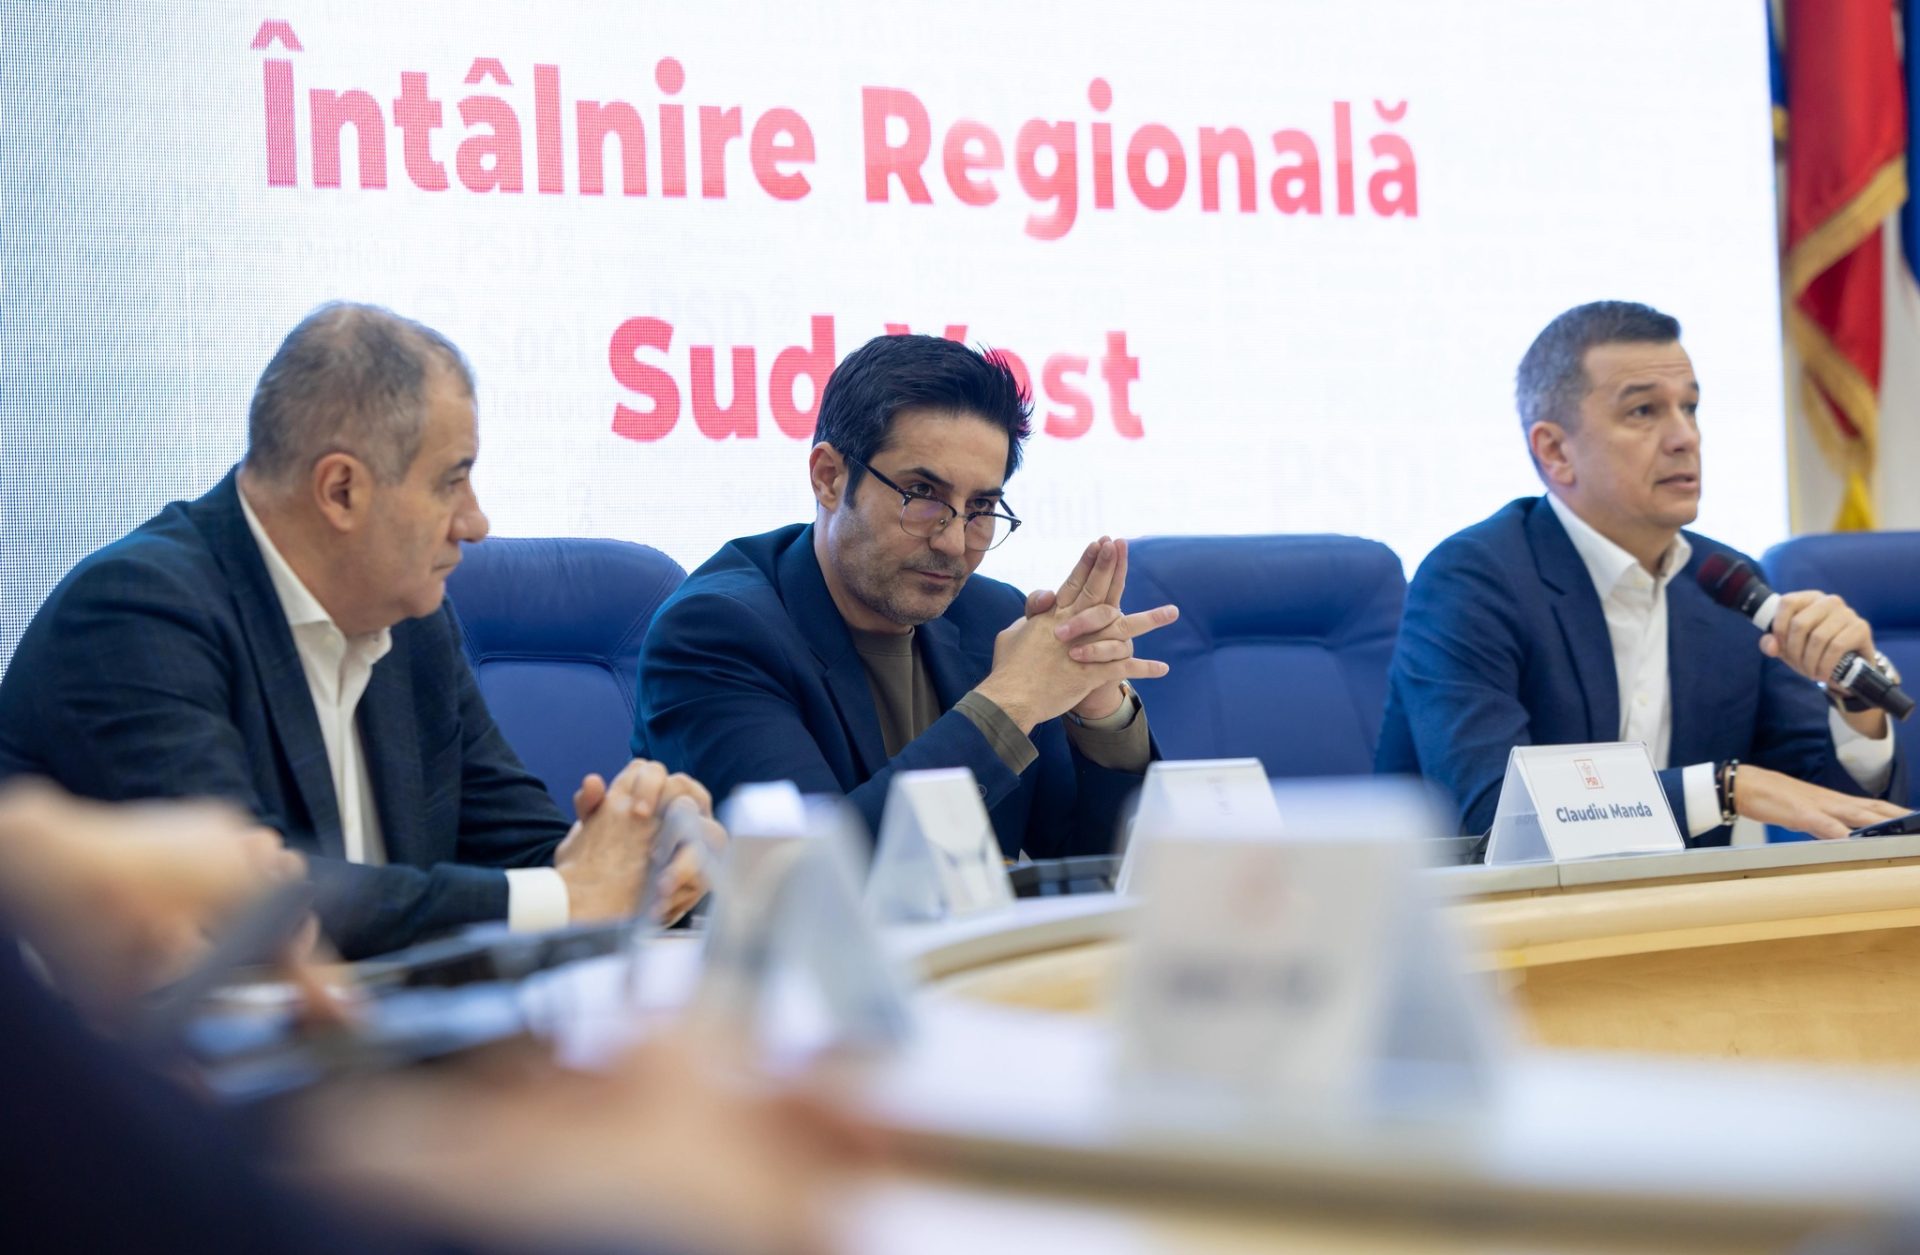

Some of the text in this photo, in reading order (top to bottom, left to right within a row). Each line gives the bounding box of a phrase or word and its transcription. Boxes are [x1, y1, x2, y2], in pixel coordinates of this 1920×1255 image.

[252, 20, 816, 202] Întâlnire
[862, 78, 1419, 241] Regională
[608, 314, 836, 443] Sud
[1556, 802, 1608, 823] Claudiu
[1608, 801, 1653, 818] Manda
